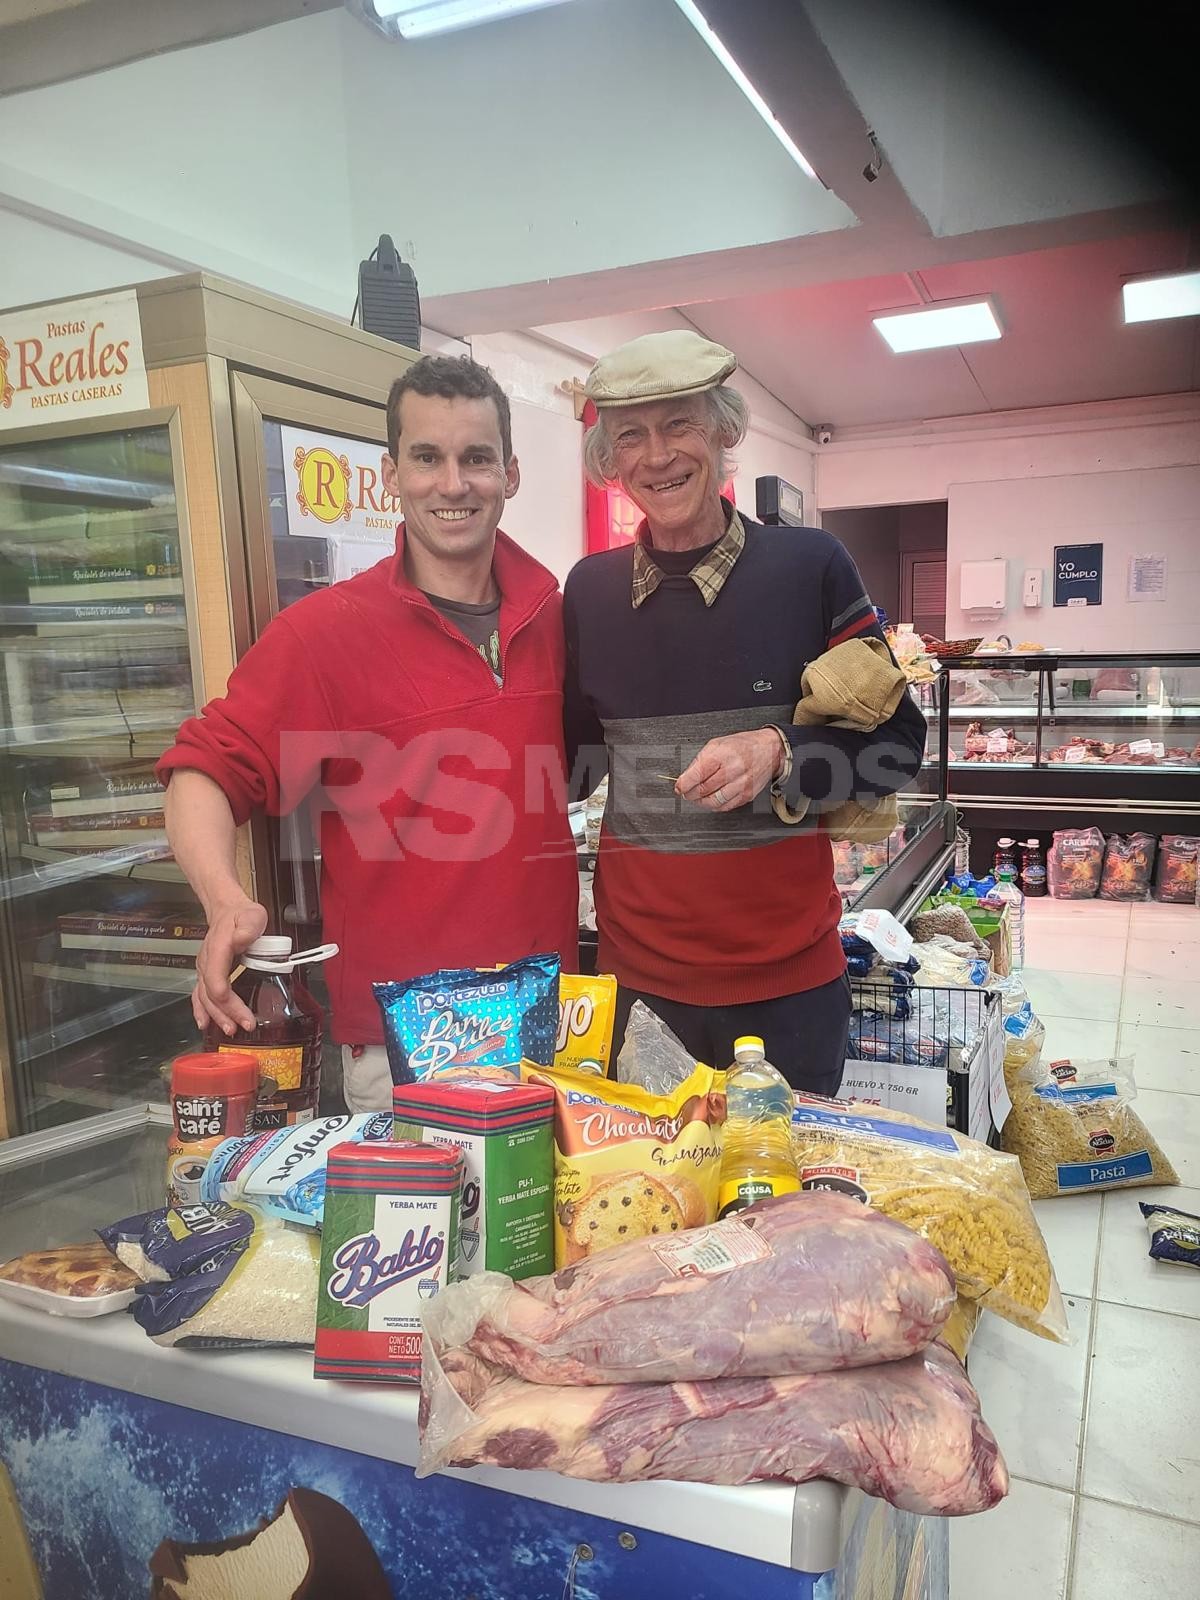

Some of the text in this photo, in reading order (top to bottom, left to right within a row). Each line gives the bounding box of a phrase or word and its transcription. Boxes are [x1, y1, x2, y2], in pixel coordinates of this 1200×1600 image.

[47, 320, 85, 338] Pastas
[14, 322, 129, 391] Reales
[31, 383, 122, 408] PASTAS CASERAS
[313, 460, 340, 509] R
[355, 465, 404, 514] Rea
[365, 517, 393, 529] PASTAS
[1058, 570, 1098, 580] CUMPLO
[1059, 562, 1075, 572] YO
[421, 1010, 480, 1045] Pan
[408, 1014, 514, 1083] Dulce
[846, 1079, 919, 1096] HUEVO X 750 GR
[175, 1099, 223, 1117] saint
[179, 1116, 221, 1135] café
[794, 1109, 875, 1130] asta
[267, 1114, 351, 1185] Comfort
[454, 1139, 473, 1150] MATE
[1090, 1165, 1126, 1181] Pasta
[738, 1186, 772, 1195] COUSA
[389, 1201, 438, 1210] YERBA MATE
[328, 1224, 445, 1306] Baldo
[388, 1345, 406, 1354] NETO
